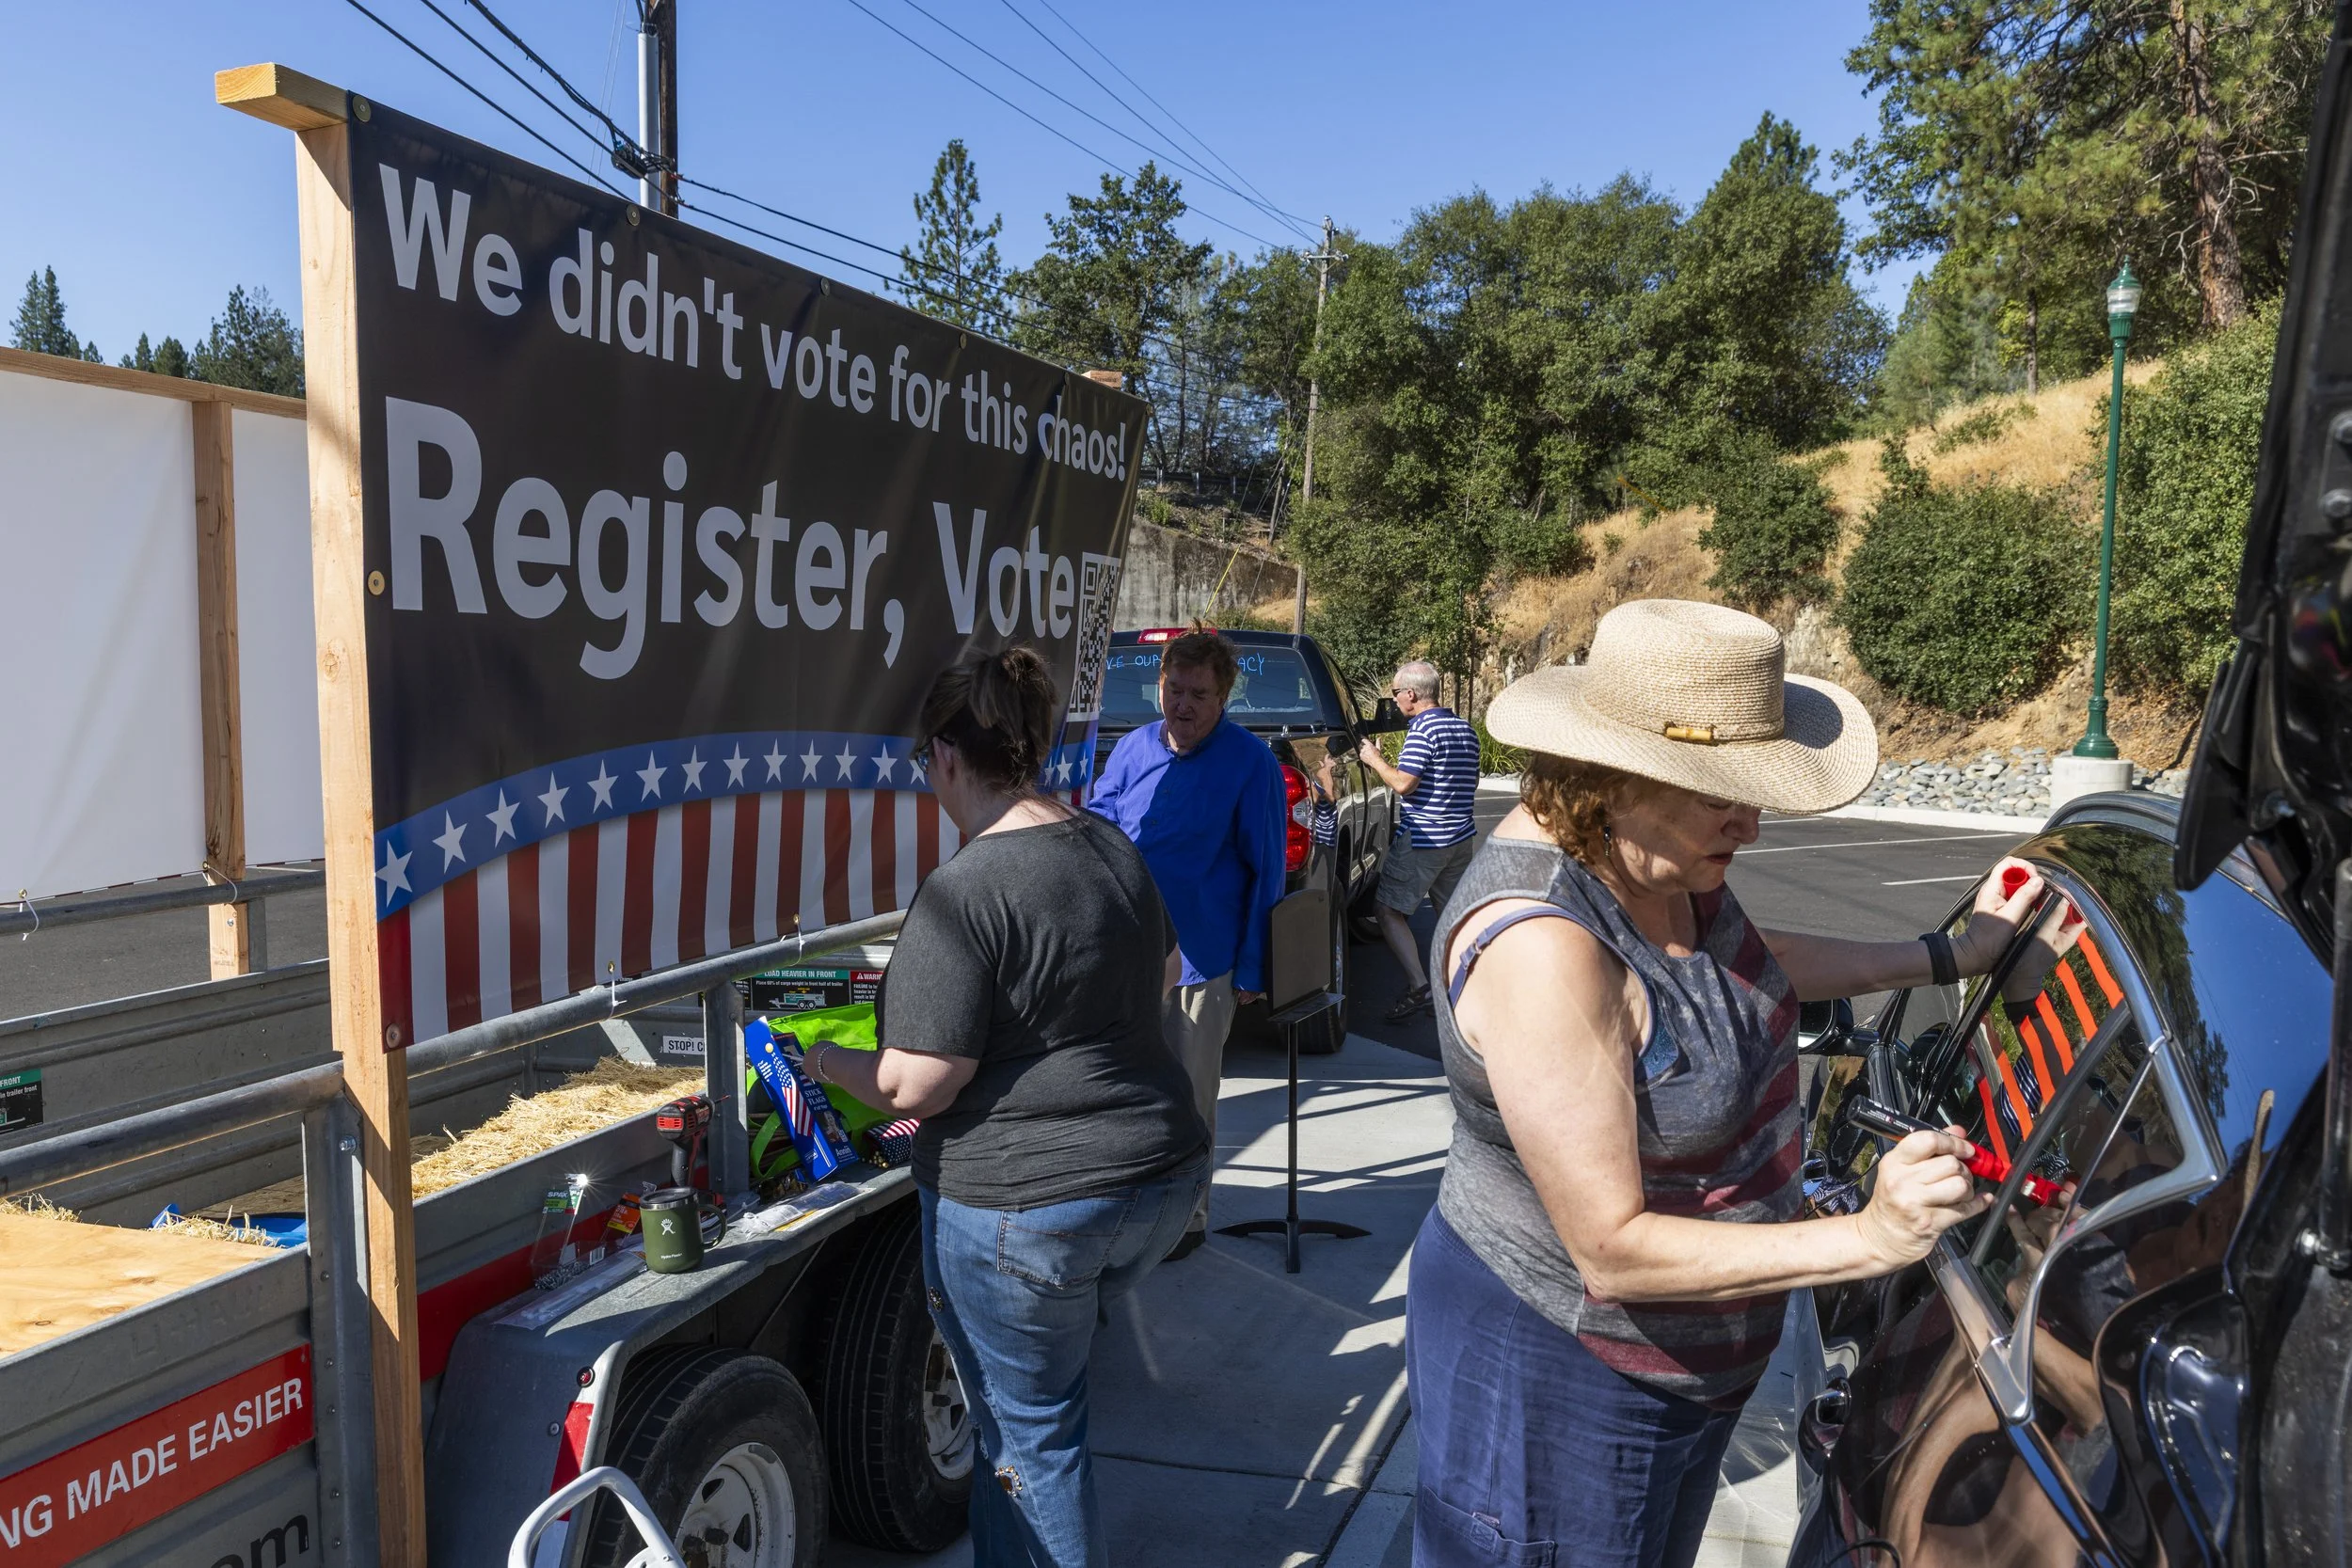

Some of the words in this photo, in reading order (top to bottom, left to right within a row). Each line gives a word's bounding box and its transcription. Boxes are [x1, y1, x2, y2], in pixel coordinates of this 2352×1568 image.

[379, 164, 522, 316] We
[549, 229, 743, 380] didn't
[761, 323, 875, 414] vote
[890, 344, 950, 433] for
[961, 370, 1028, 455] this
[1038, 395, 1126, 482] chaos!
[386, 396, 905, 680] Register,
[933, 502, 1074, 638] Vote
[668, 1039, 694, 1052] STOP!
[804, 1087, 822, 1098] STICK
[807, 1095, 827, 1105] FLAGS
[67, 1434, 178, 1521] MADE
[188, 1378, 303, 1461] EASIER
